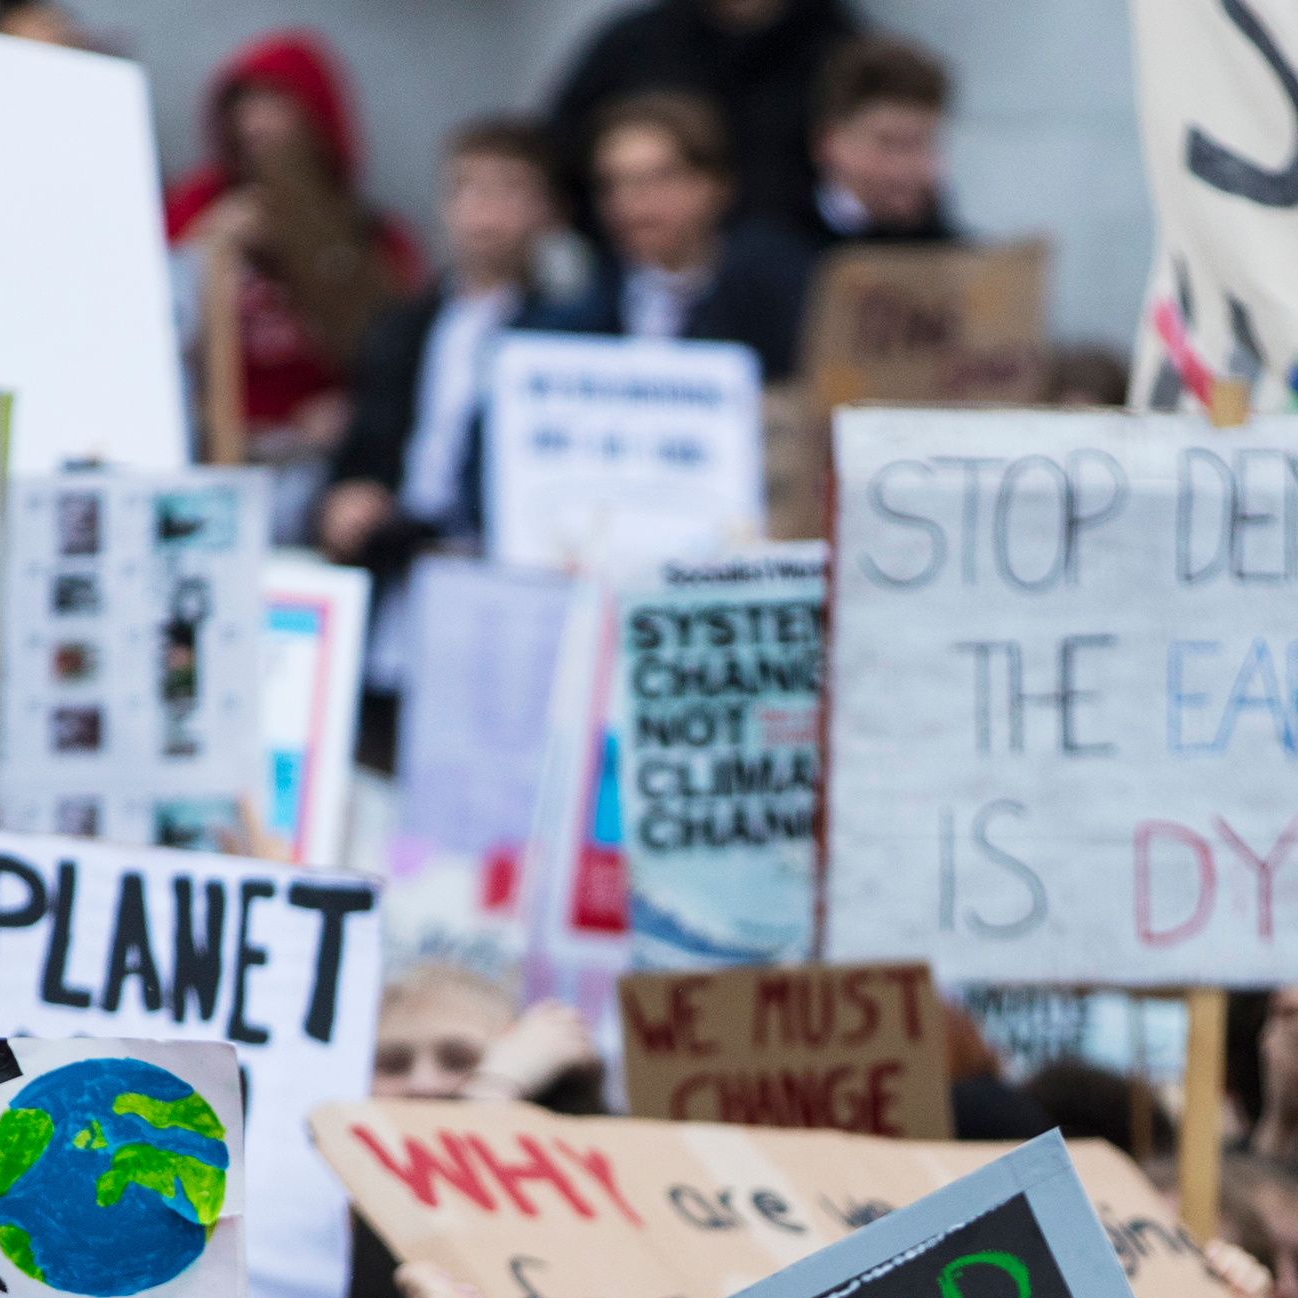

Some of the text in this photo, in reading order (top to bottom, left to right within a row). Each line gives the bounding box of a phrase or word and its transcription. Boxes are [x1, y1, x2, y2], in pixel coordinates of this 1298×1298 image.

[857, 446, 1131, 592] STOP
[636, 705, 747, 749] NOT
[953, 632, 1118, 756] THE
[937, 798, 1049, 940] IS
[752, 964, 929, 1050] MUST
[350, 1123, 645, 1229] WHY
